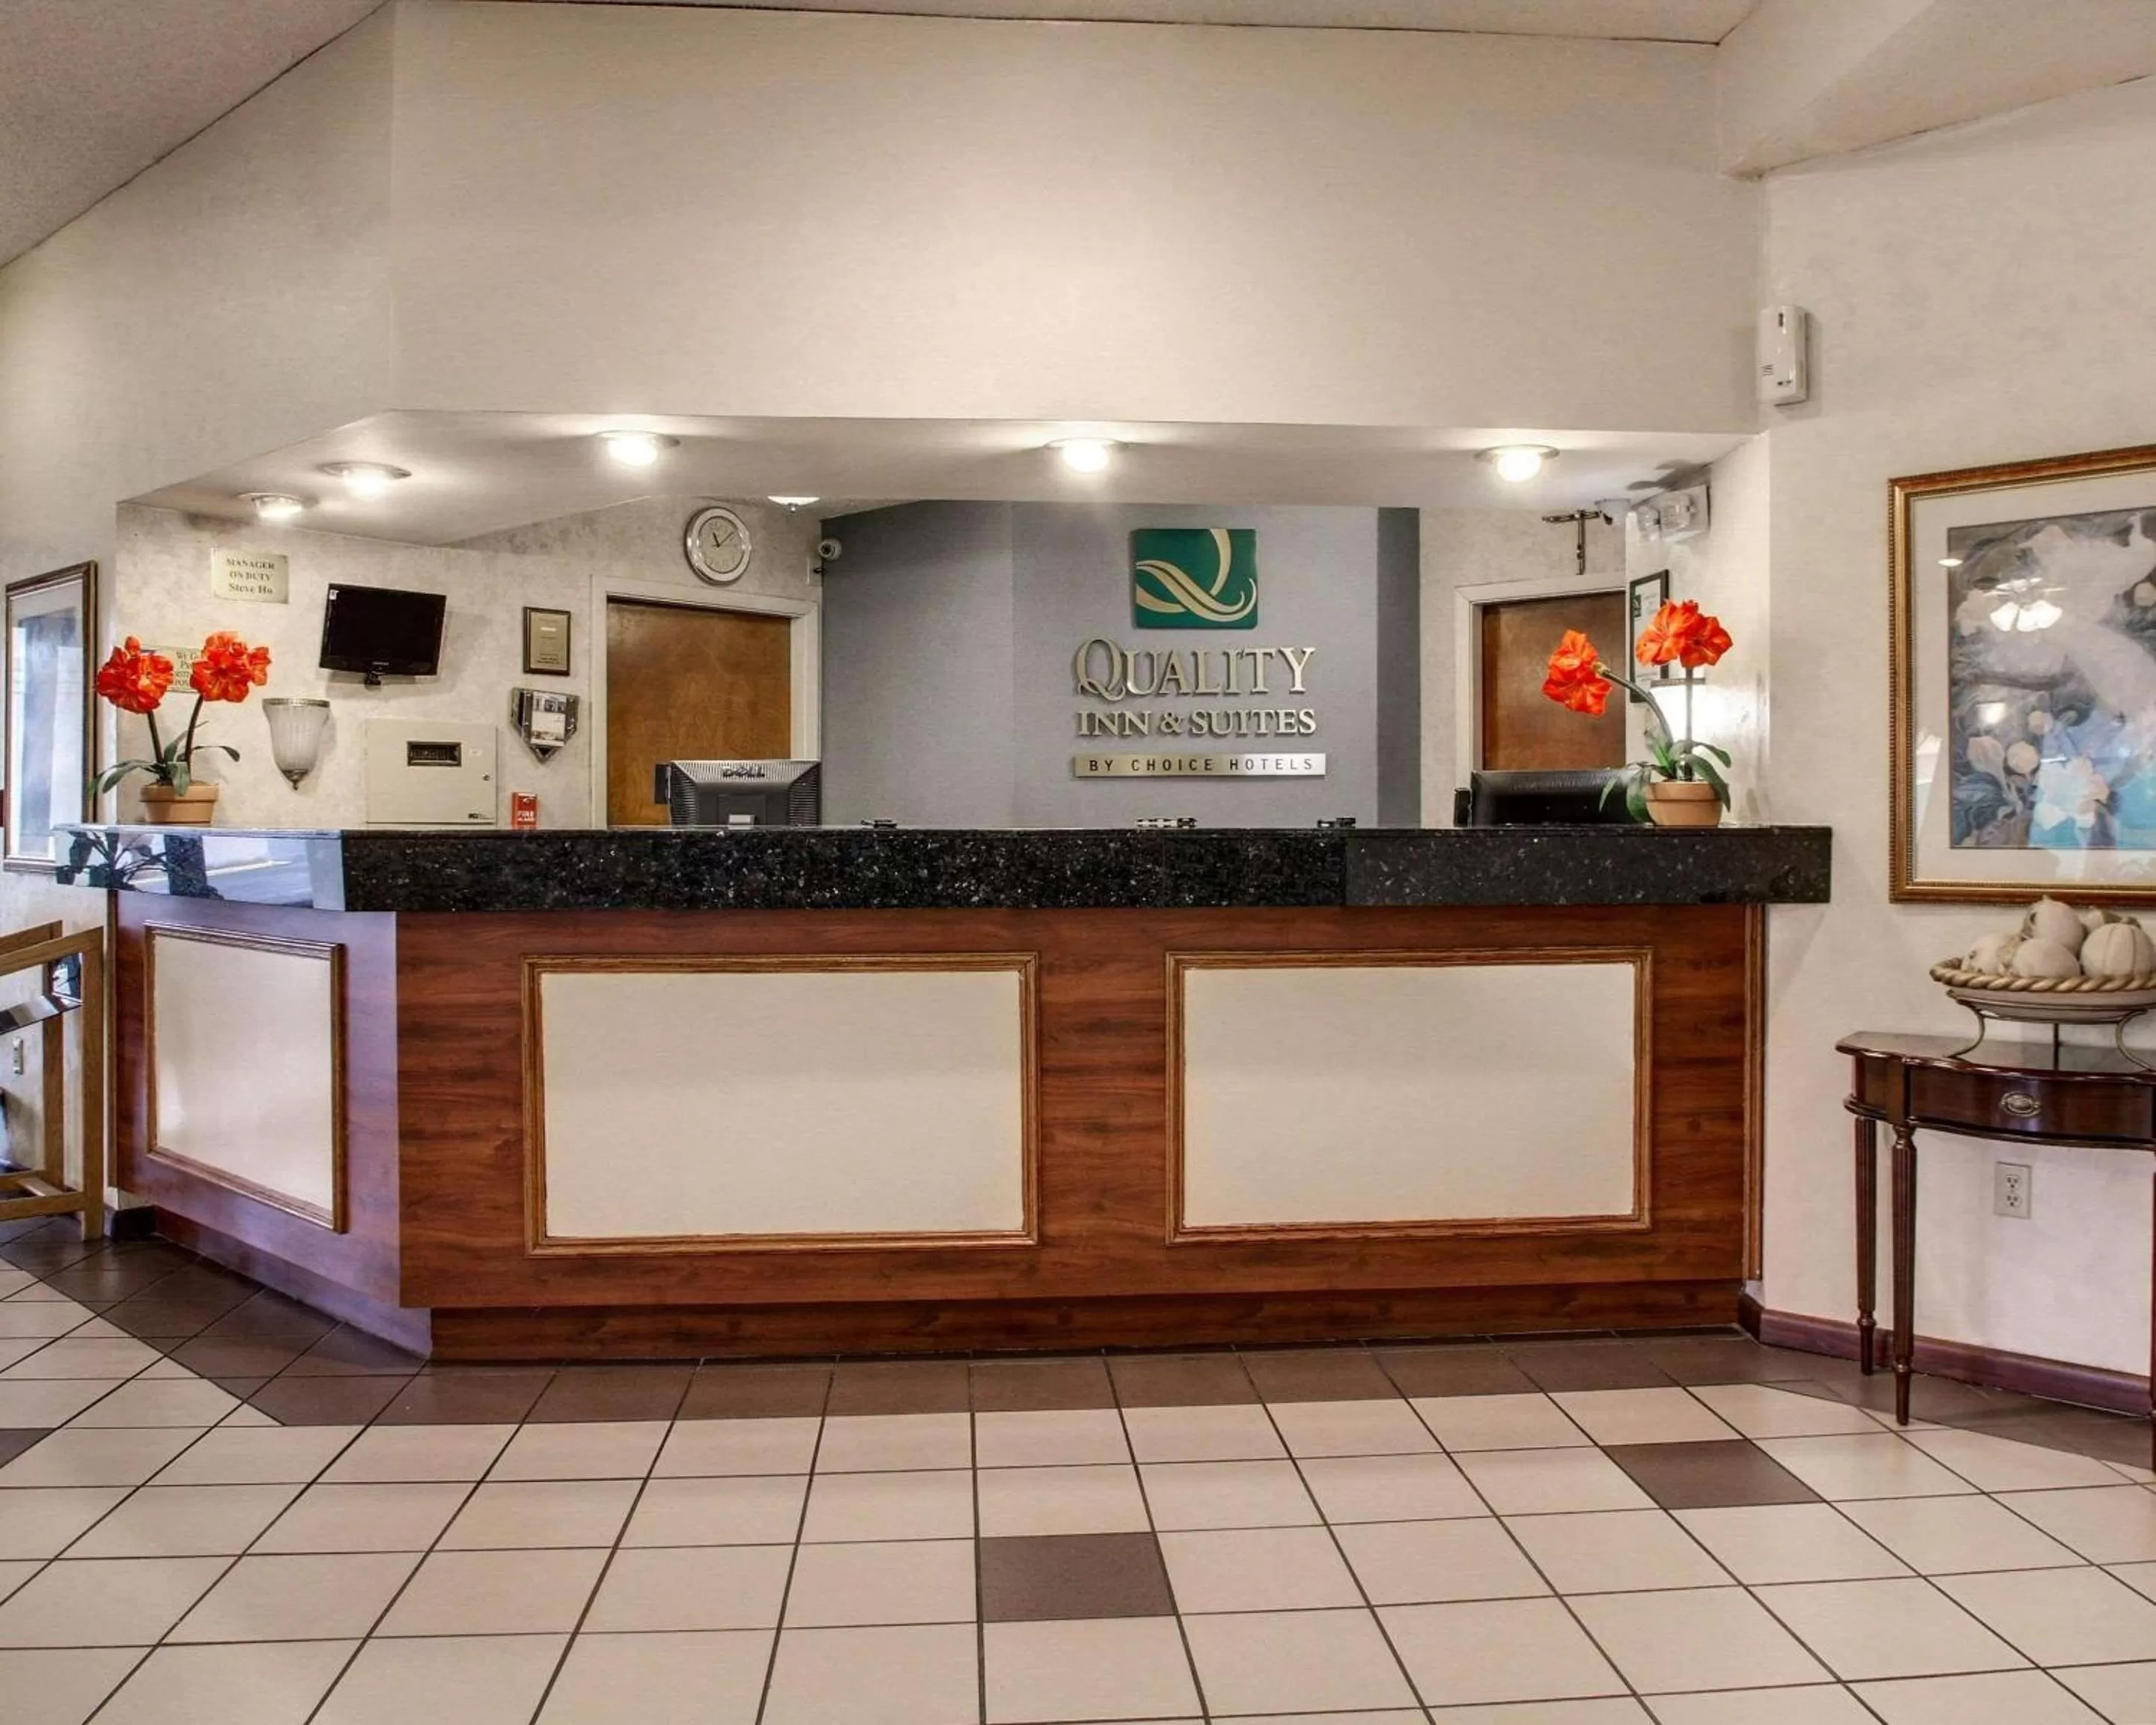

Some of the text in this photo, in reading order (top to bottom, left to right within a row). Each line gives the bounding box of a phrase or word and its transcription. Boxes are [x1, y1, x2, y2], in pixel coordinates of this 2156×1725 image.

[227, 558, 275, 570] MANAGER
[230, 571, 273, 581] ON DUTY
[1074, 638, 1315, 702] QUALITY
[1078, 708, 1316, 736] INN & SUITES
[1088, 758, 1313, 772] BY CHOICE HOTELS
[722, 767, 764, 778] DELL
